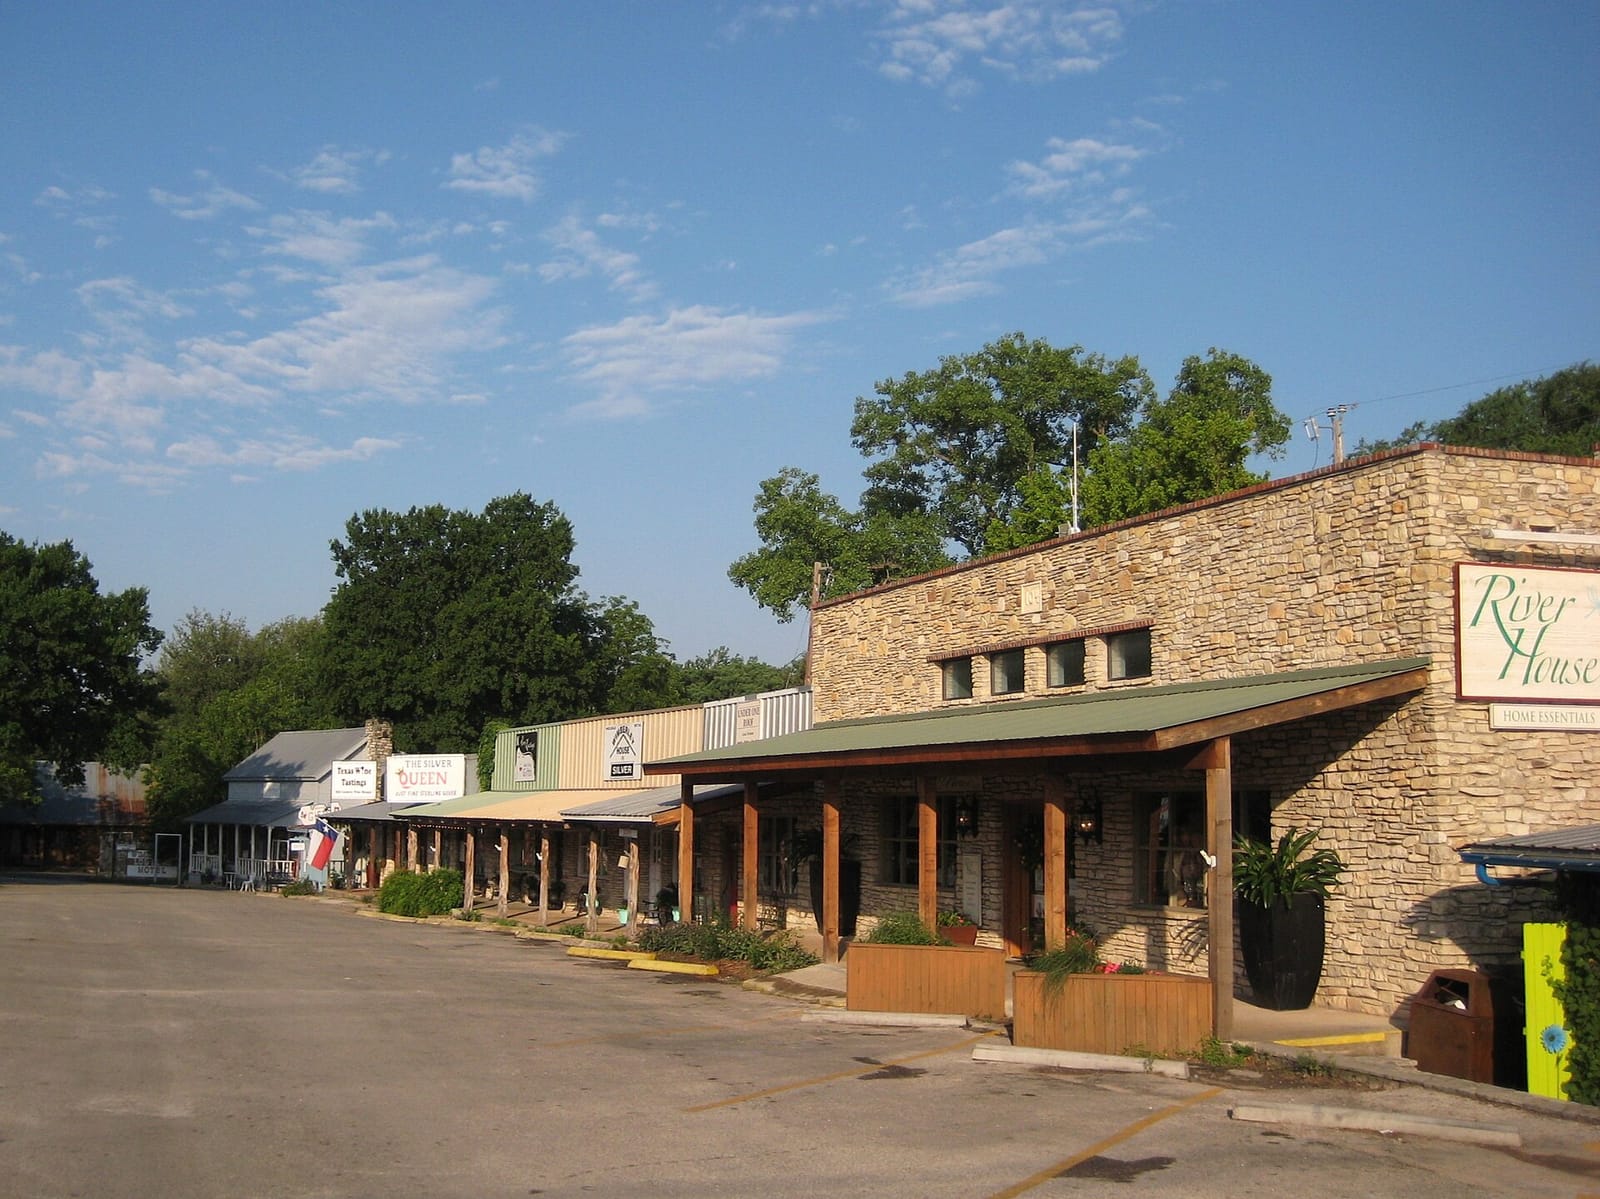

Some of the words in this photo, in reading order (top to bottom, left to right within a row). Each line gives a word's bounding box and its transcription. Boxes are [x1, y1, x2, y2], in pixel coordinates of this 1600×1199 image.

[1469, 574, 1576, 657] River
[1497, 621, 1600, 686] House
[1503, 710, 1535, 723] HOME
[1538, 710, 1596, 724] ESSENTIALS
[616, 746, 630, 754] HOUSE
[405, 760, 422, 768] THE
[423, 760, 453, 768] SILVER
[337, 767, 354, 775] Texas
[612, 765, 633, 775] SILVER
[341, 778, 367, 787] Tastings
[399, 771, 448, 789] QUEEN
